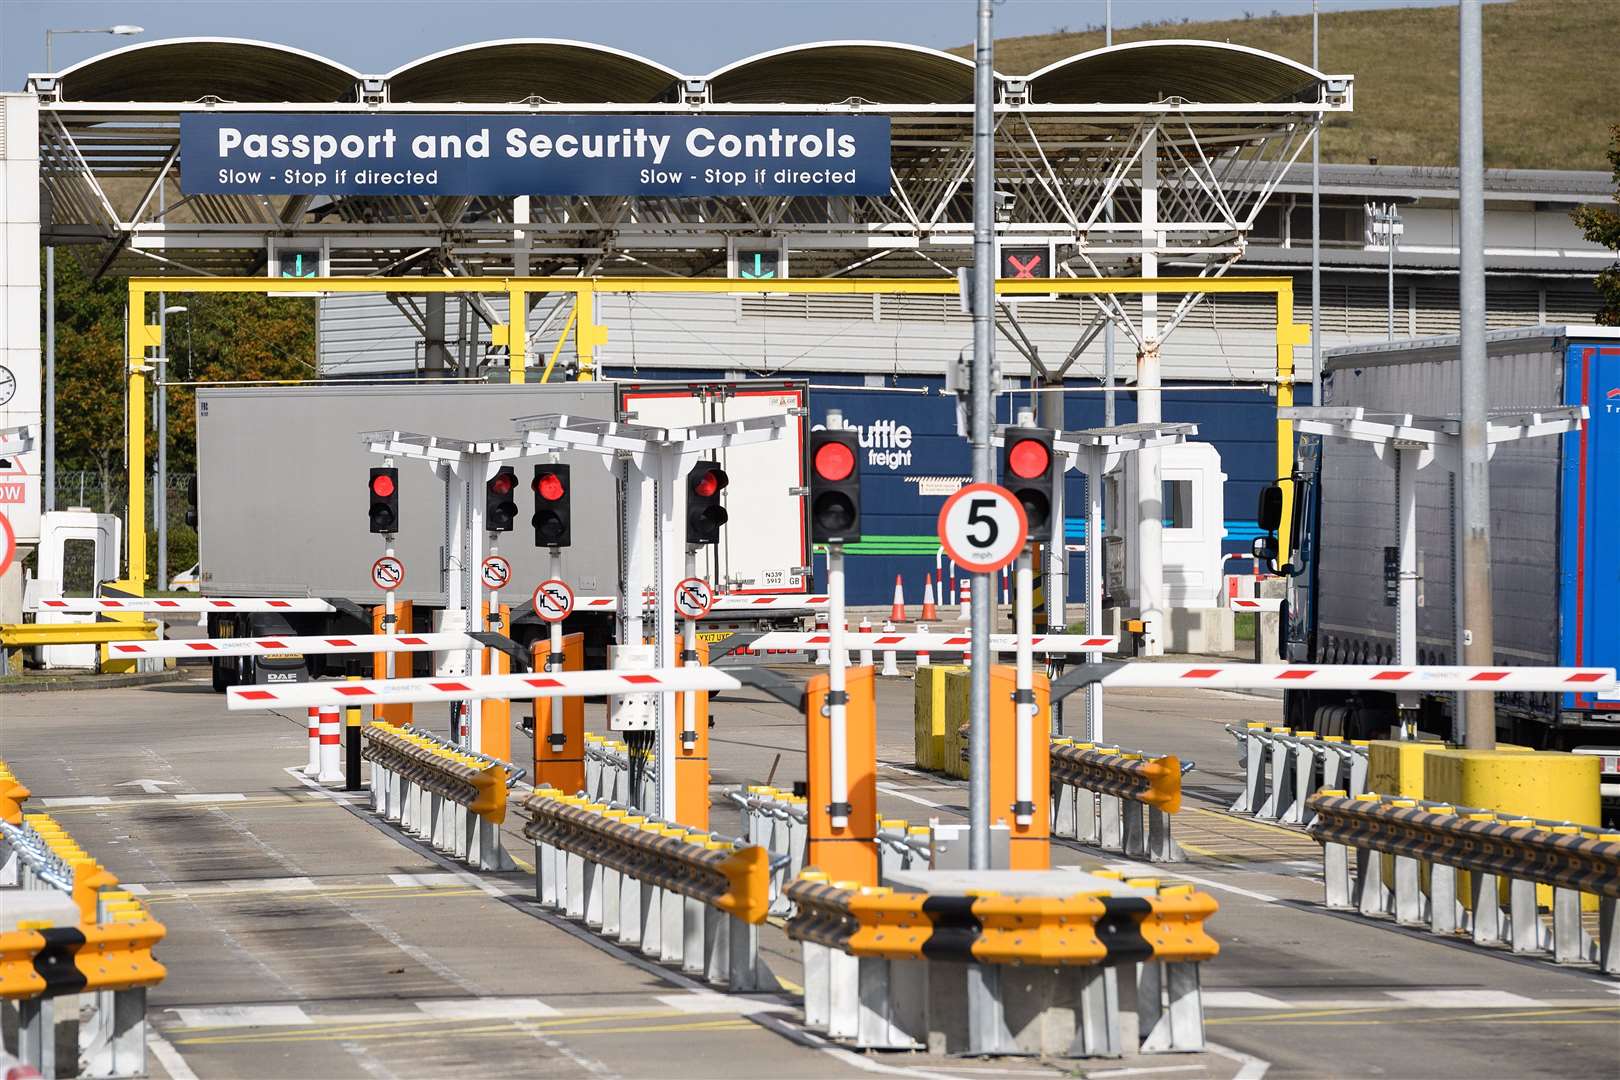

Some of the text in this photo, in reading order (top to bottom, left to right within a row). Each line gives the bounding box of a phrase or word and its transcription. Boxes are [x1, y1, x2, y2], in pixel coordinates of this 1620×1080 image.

[218, 127, 856, 165] Passport and Security Controls
[218, 168, 262, 184] Slow
[284, 168, 327, 187] Stop
[335, 169, 347, 184] if
[354, 169, 438, 185] directed
[639, 168, 683, 184] Slow
[704, 168, 747, 187] Stop
[754, 168, 767, 184] if
[773, 168, 856, 184] directed
[868, 448, 912, 470] freight
[966, 499, 999, 549] 5
[972, 551, 993, 559] mph
[789, 577, 800, 585] GB
[267, 673, 298, 681] DAF
